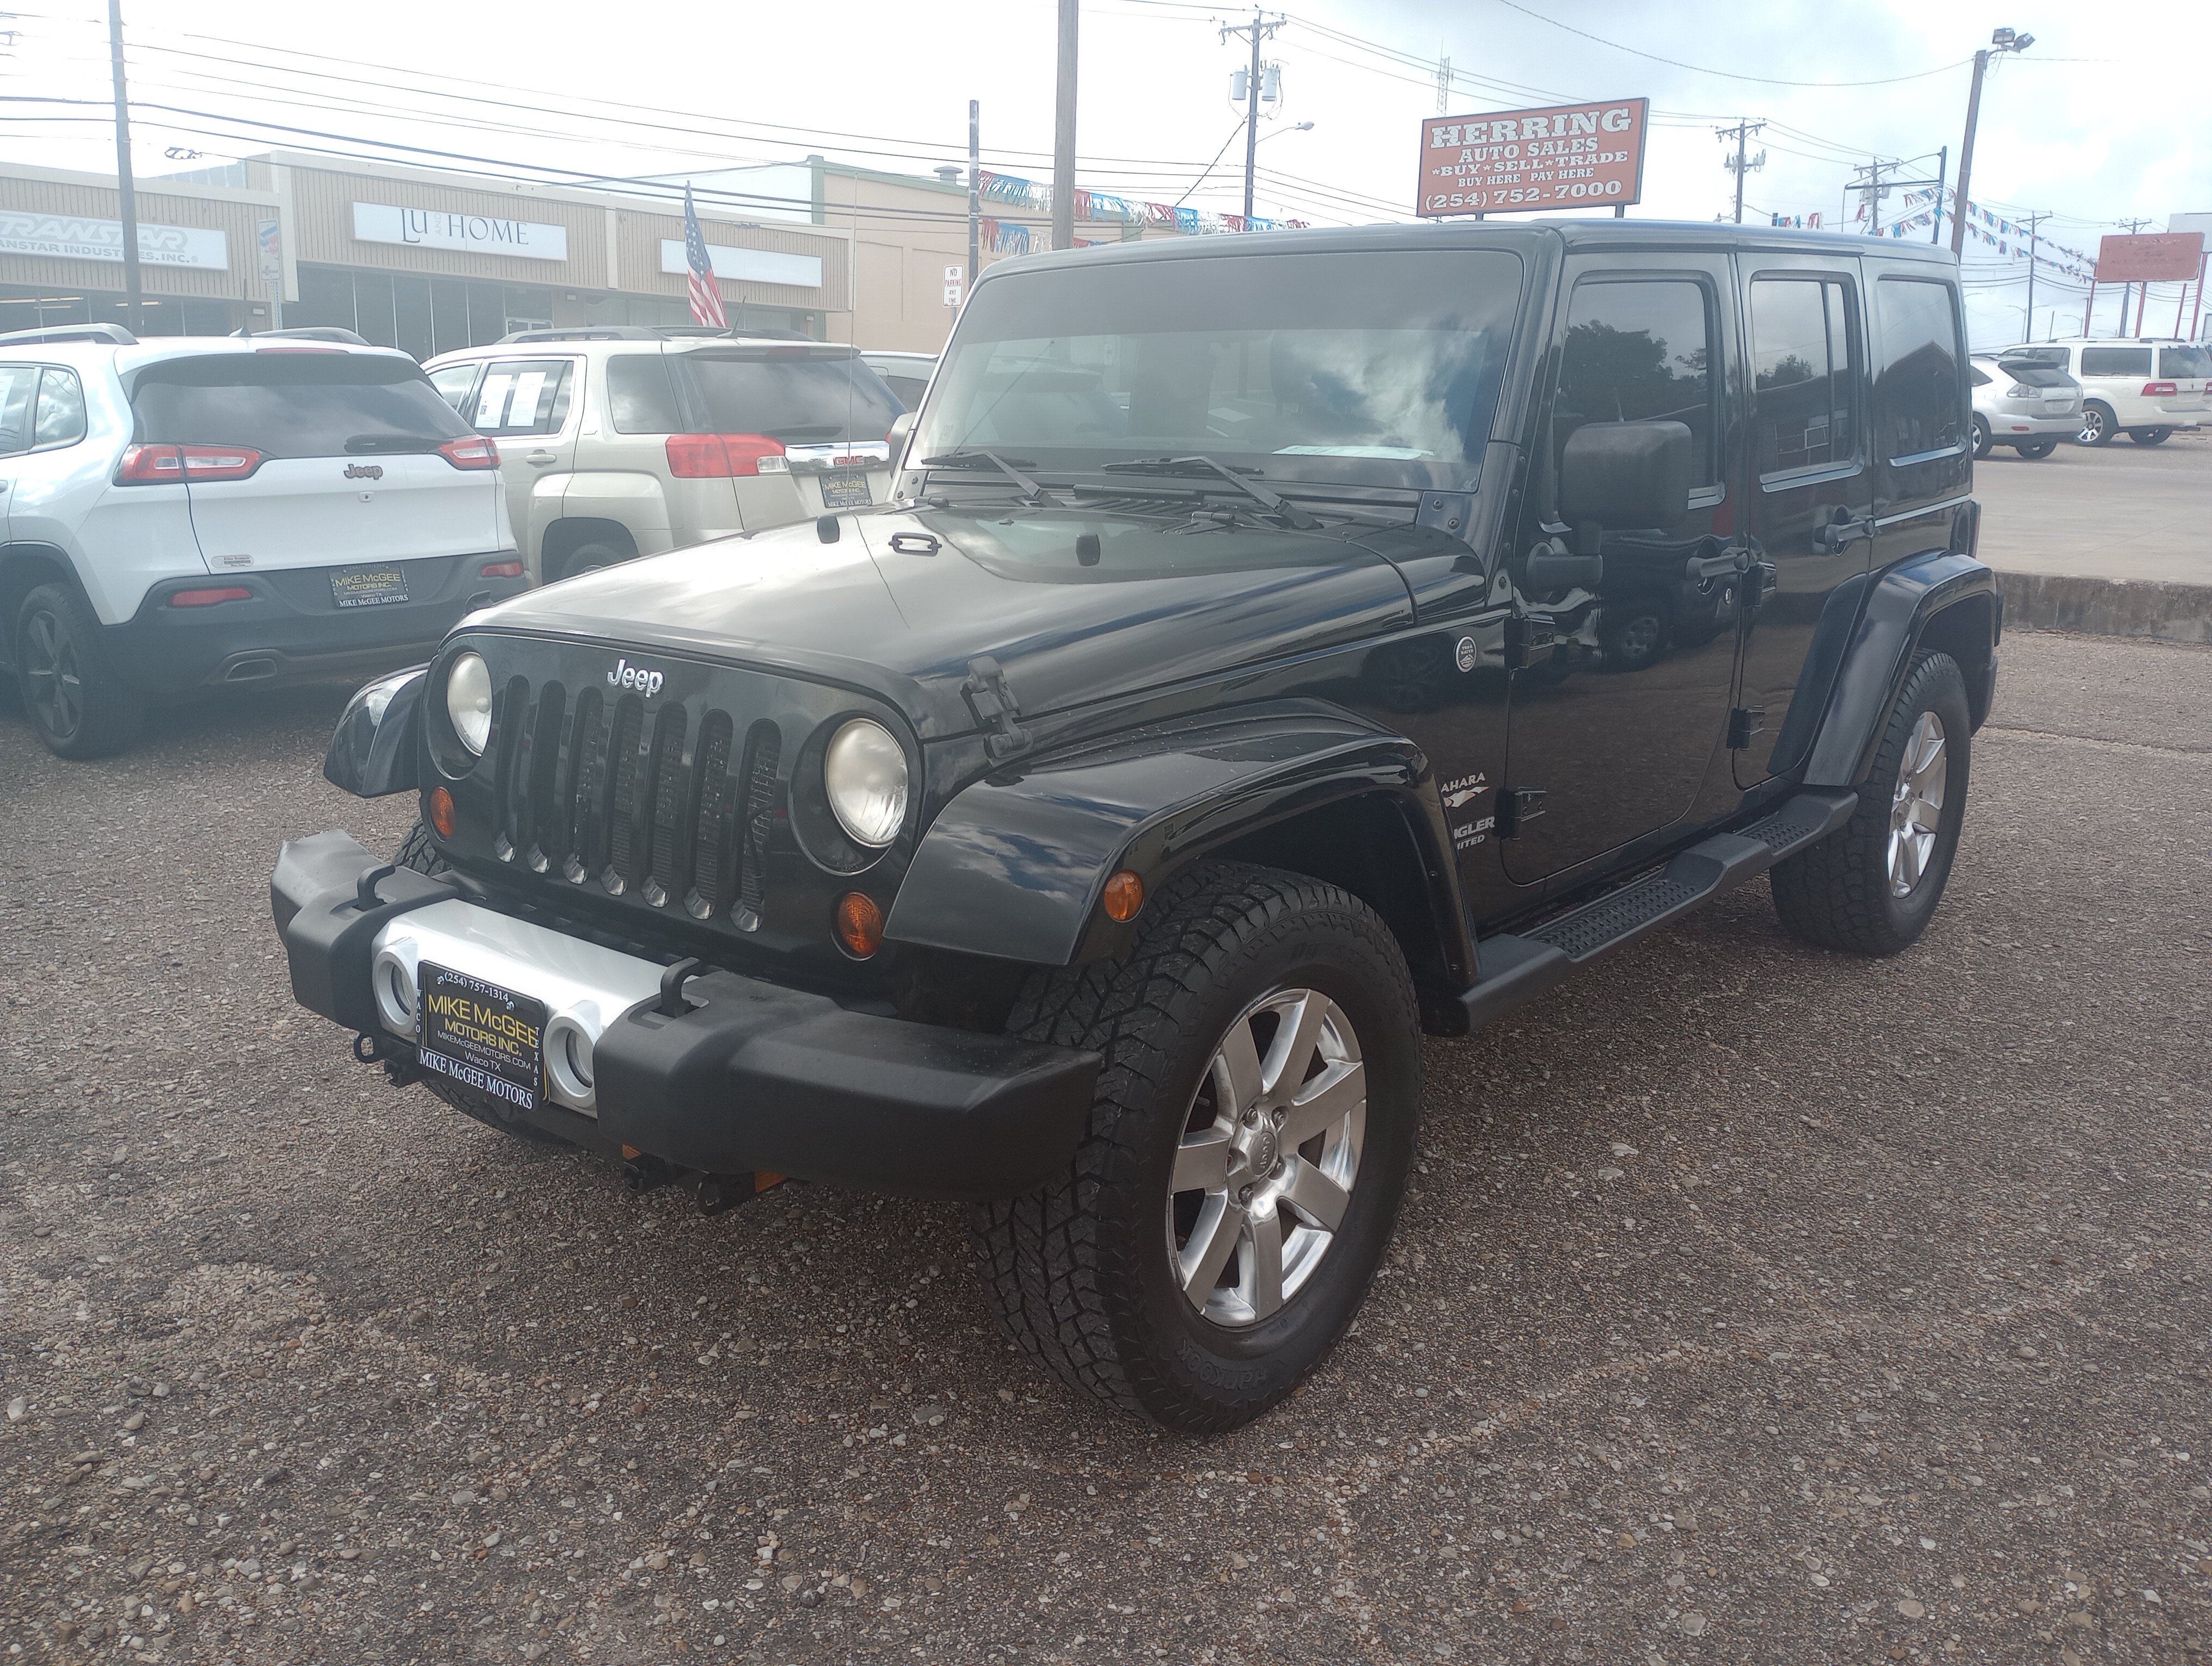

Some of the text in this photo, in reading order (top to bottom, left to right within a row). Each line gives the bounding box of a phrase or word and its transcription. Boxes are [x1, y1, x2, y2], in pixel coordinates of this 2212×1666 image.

[1430, 108, 1632, 149] HERRING
[1458, 137, 1599, 163] AUTO SALES
[1458, 168, 1594, 188] BUY HERE PAY HERE
[1425, 180, 1622, 211] (254) 752-7000
[448, 214, 529, 245] HOME
[945, 279, 961, 287] PARKING
[950, 268, 957, 277] NO
[343, 463, 383, 480] Jeep
[834, 456, 864, 467] GMC
[825, 481, 841, 491] MIKE
[336, 573, 401, 587] MIKE McGEE
[347, 582, 377, 591] MOTORS
[358, 597, 380, 605] McGEE
[381, 594, 409, 604] MOTORS
[607, 659, 664, 698] Jeep
[445, 971, 509, 1002] (254) 757-1314
[428, 994, 536, 1048] MIKE McGEE
[445, 1017, 522, 1056] MOTORS INC.
[465, 1050, 501, 1073] Waco TX
[420, 1048, 533, 1110] MIKE McGEE MOTORS
